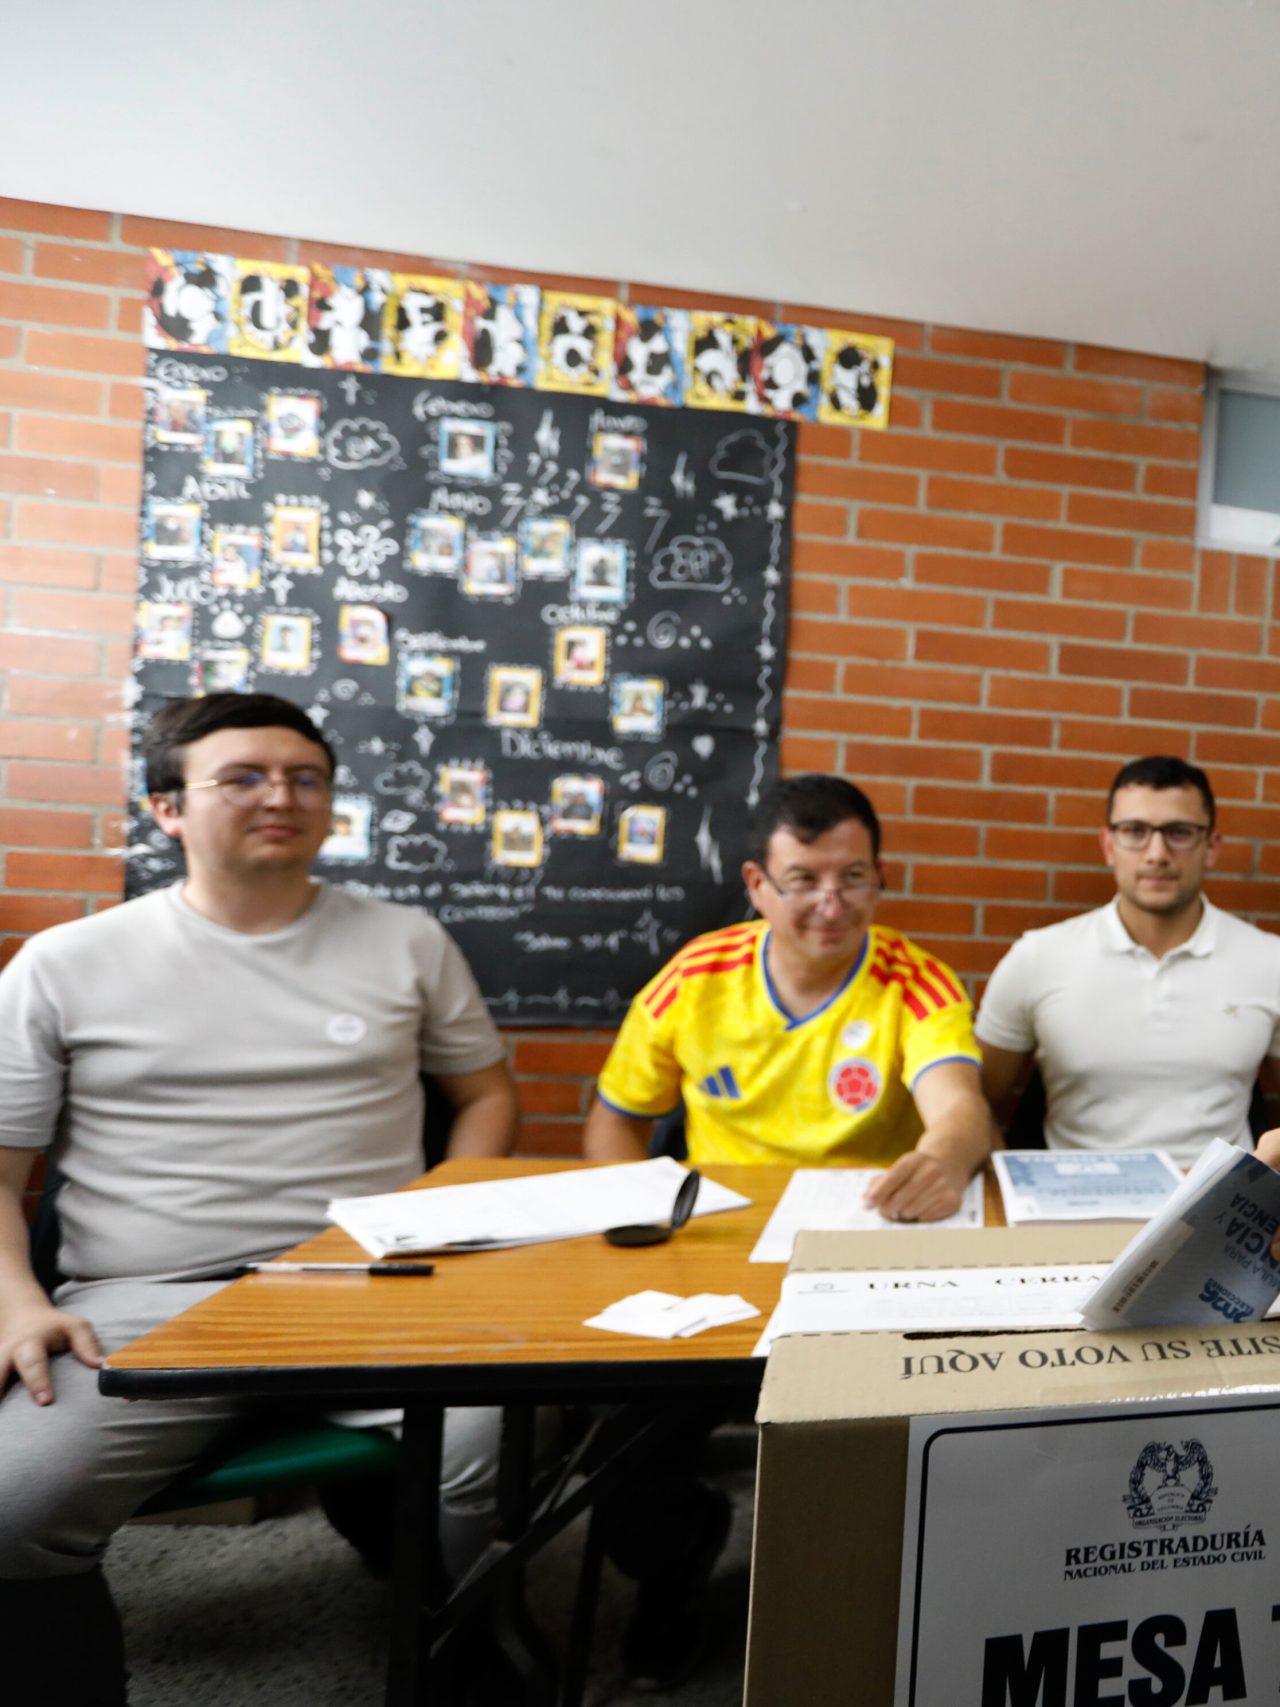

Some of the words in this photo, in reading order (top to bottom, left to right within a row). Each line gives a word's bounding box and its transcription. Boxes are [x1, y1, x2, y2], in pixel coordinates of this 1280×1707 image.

[1212, 1211, 1227, 1225] Y
[1230, 1193, 1280, 1236] ENCIA
[1223, 1243, 1253, 1269] PARA
[995, 1273, 1101, 1288] CERRA
[1018, 1344, 1133, 1369] VOTO
[1142, 1338, 1191, 1362] SU
[900, 1350, 1004, 1380] AQUÍ
[1064, 1524, 1267, 1567] REGISTRADURÍA
[1064, 1561, 1136, 1582] NACIONAL
[1140, 1559, 1168, 1572] DEL
[1173, 1551, 1227, 1569] ESTADO
[1230, 1549, 1267, 1563] CIVIL
[980, 1607, 1248, 1707] MESA
